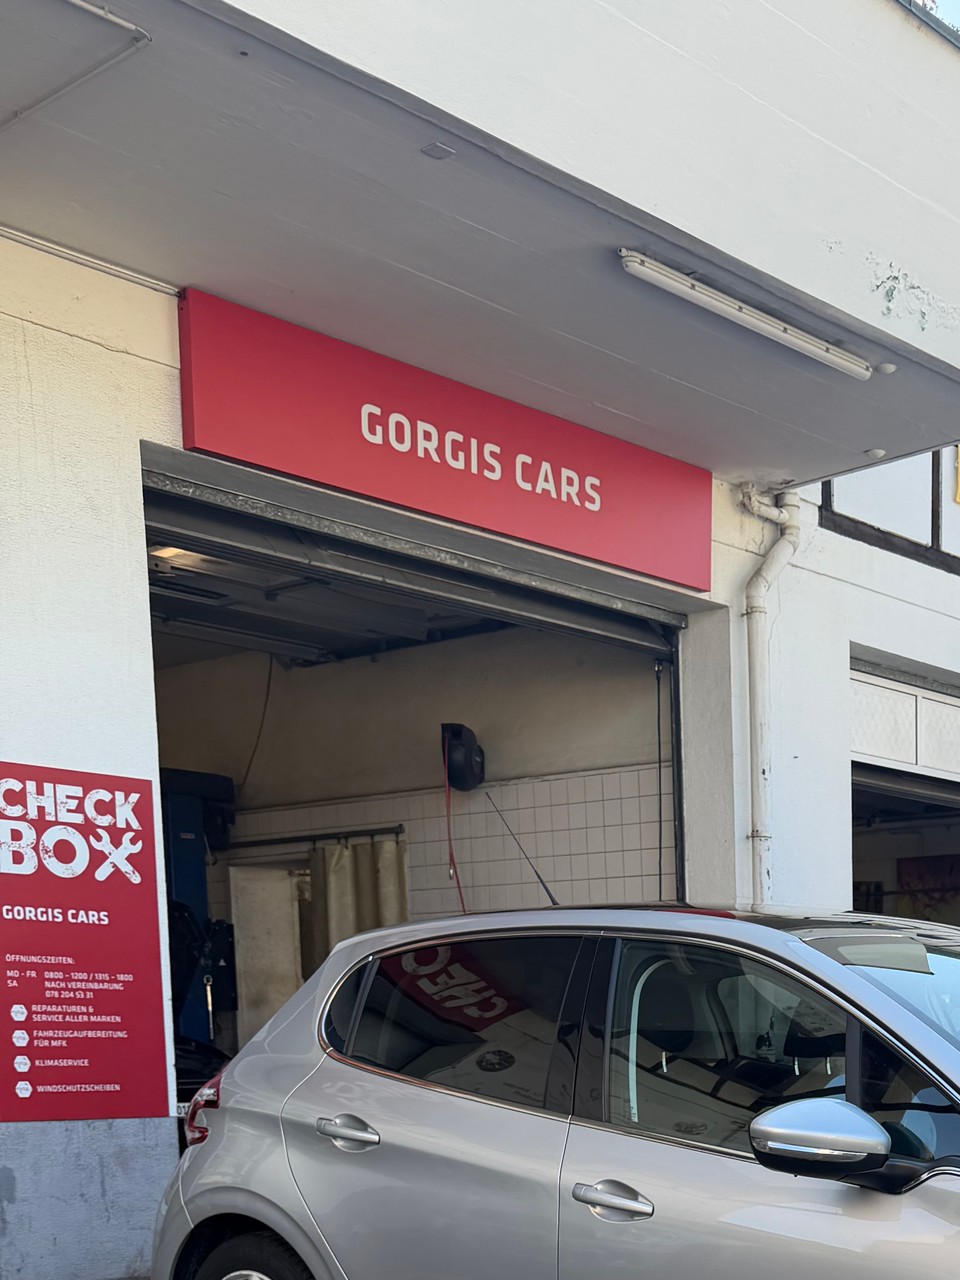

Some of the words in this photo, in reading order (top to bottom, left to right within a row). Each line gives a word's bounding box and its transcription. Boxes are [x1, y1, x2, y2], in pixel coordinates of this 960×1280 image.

[361, 403, 502, 481] GORGIS
[515, 453, 601, 512] CARS
[0, 777, 143, 830] CHECK
[0, 819, 143, 885] BOX
[2, 905, 64, 923] GORGIS
[67, 909, 109, 925] CARS
[5, 954, 76, 965] ÖFFNUNGSZEITEN:
[6, 970, 20, 978] MO
[26, 970, 37, 978] FR
[44, 971, 64, 979] 0800
[70, 972, 88, 980] 1200
[94, 973, 110, 981] 1315
[116, 974, 134, 982] 1800
[44, 981, 66, 989] NACH
[67, 982, 124, 990] VEREINBARUNG
[45, 990, 59, 998] 078
[31, 1005, 88, 1013] REPARATUREN
[32, 1014, 64, 1022] SERVICE
[90, 1015, 122, 1023] MARKEN
[33, 1030, 128, 1039] FAHRZEUGAUFBEREITUNG
[33, 1038, 50, 1047] FÜR
[50, 1039, 68, 1047] MFK
[35, 1058, 90, 1067] KLIMASERVICE
[37, 1084, 121, 1093] WINDSCHUTZSCHEIBEN
